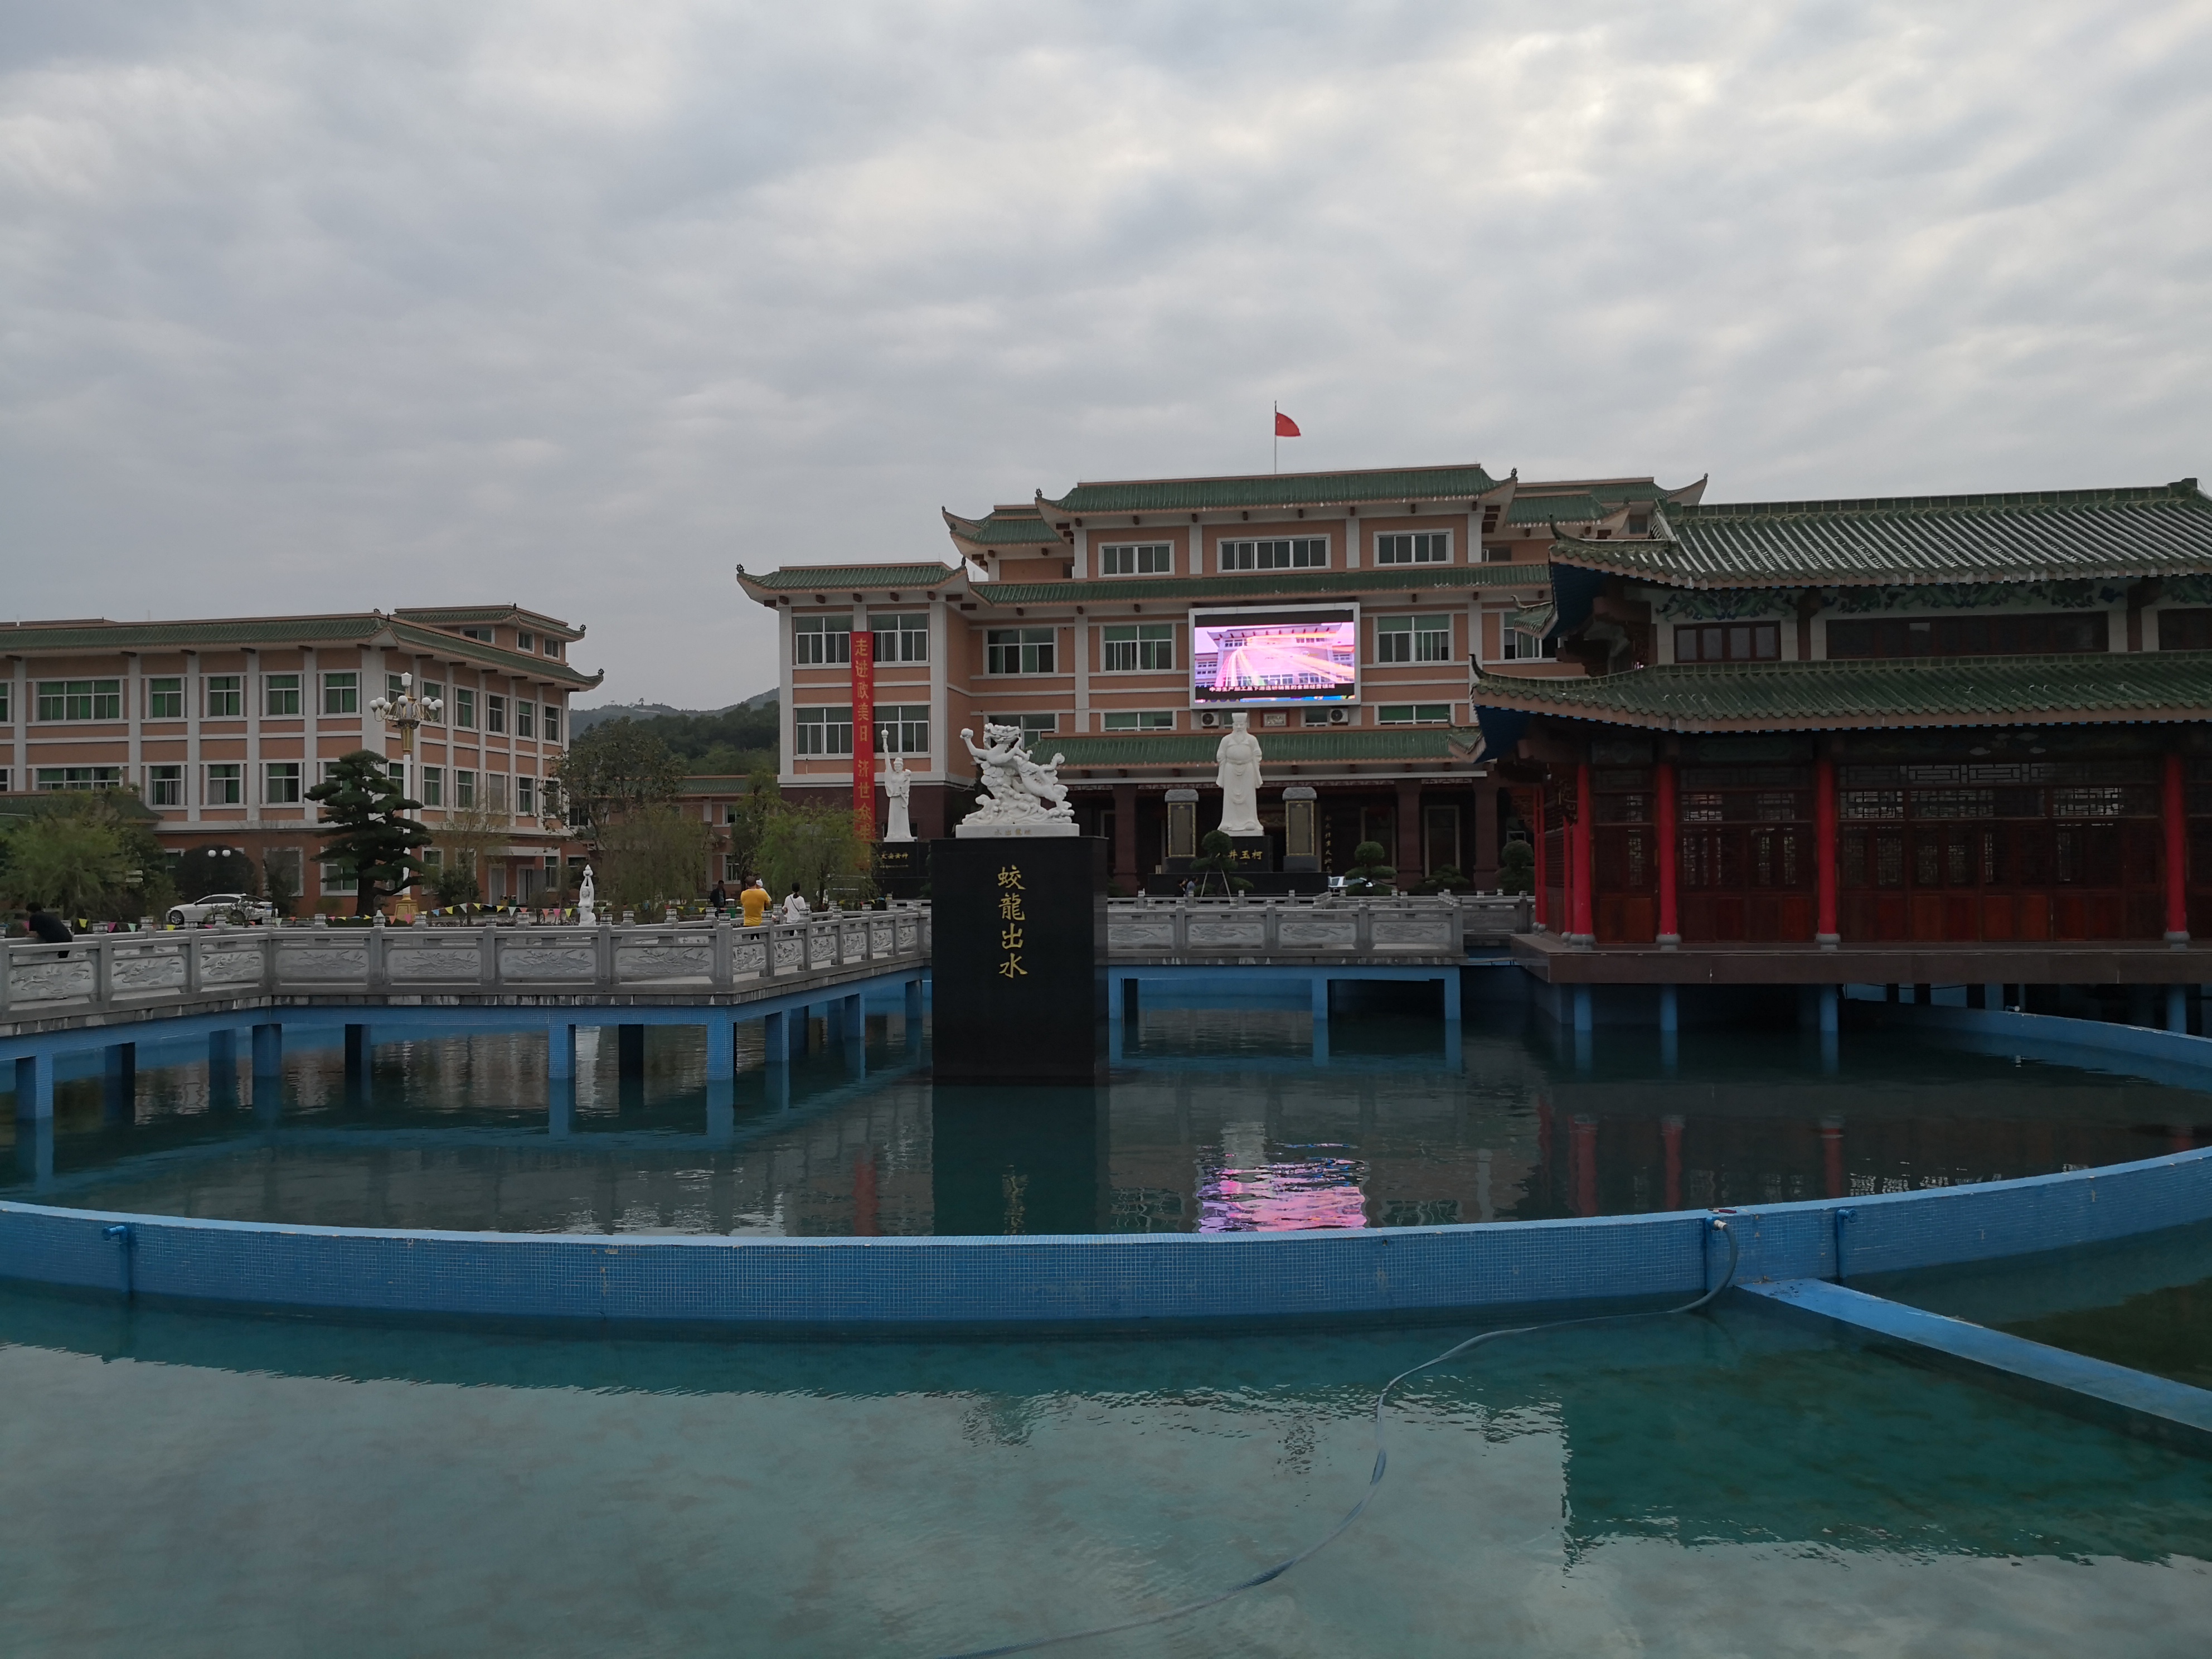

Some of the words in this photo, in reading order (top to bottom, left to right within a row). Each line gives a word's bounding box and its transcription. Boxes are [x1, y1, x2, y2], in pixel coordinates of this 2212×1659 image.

[855, 638, 869, 741] 走进欧美日
[997, 865, 1027, 978] 蛟龍出水
